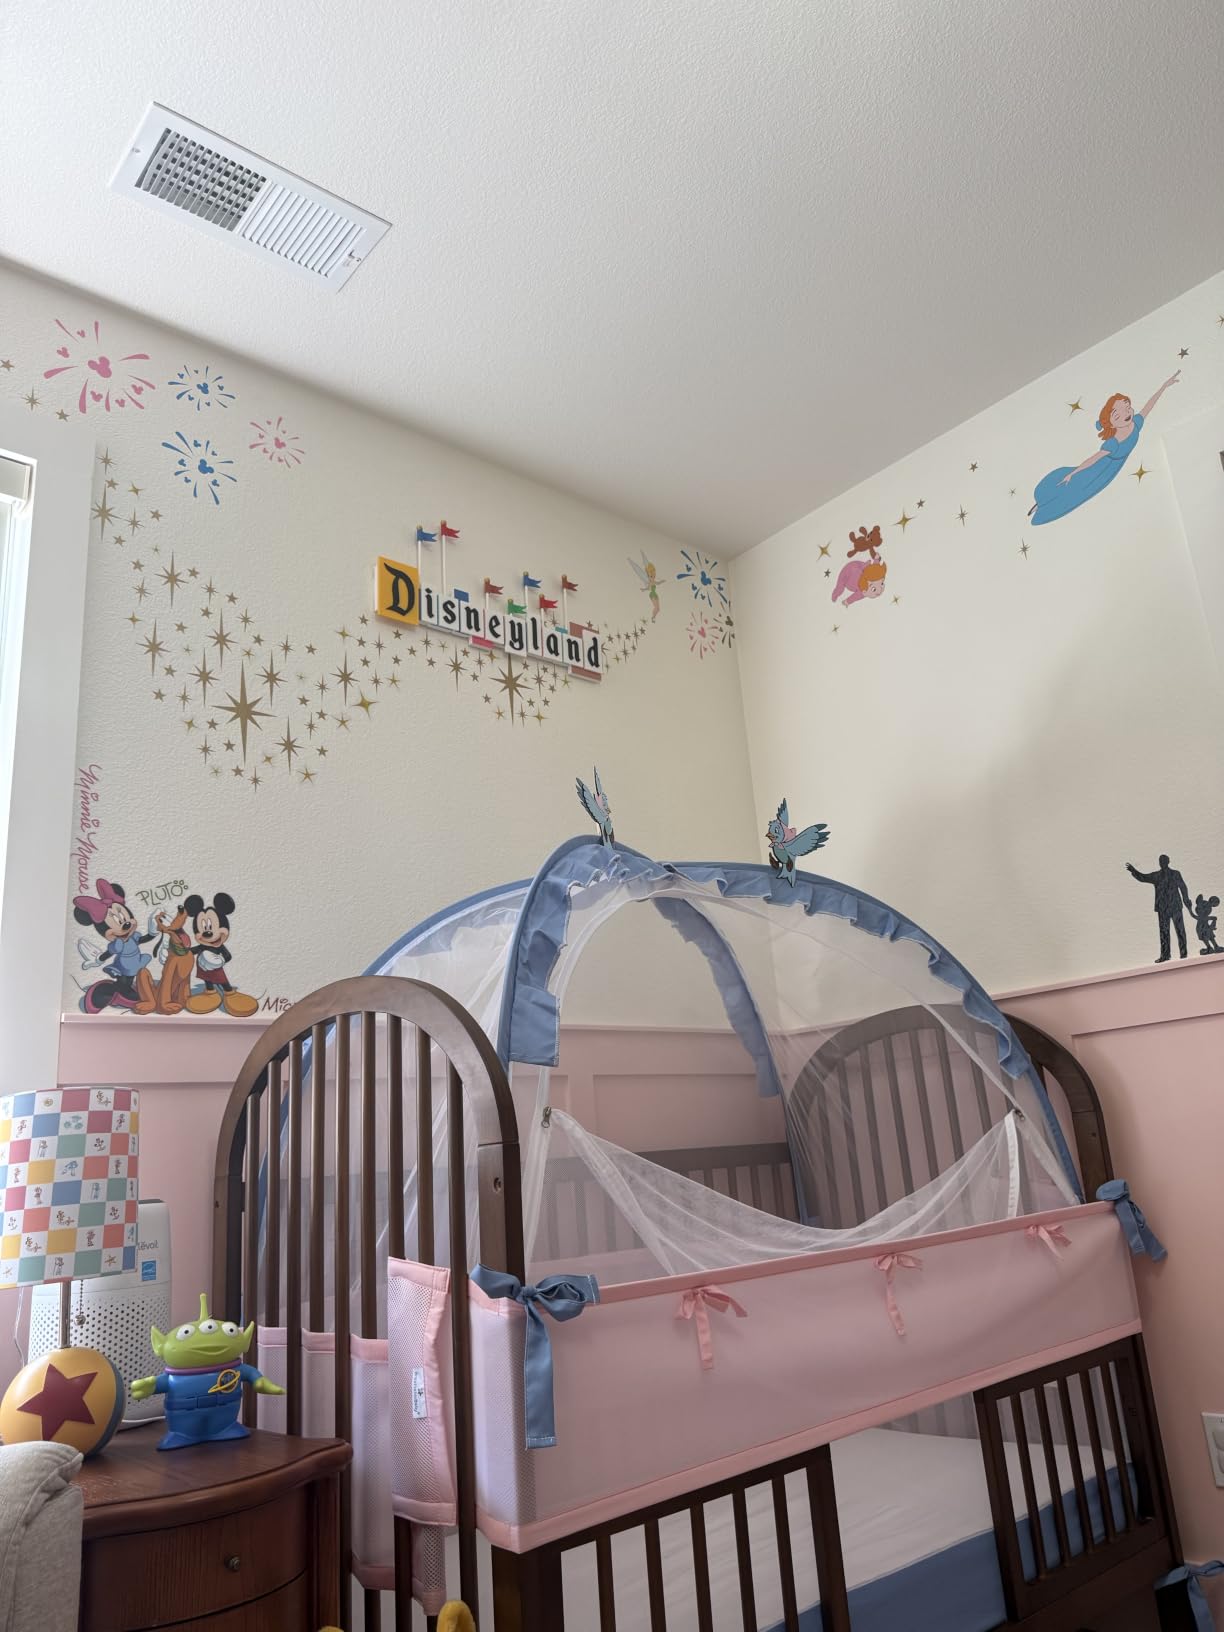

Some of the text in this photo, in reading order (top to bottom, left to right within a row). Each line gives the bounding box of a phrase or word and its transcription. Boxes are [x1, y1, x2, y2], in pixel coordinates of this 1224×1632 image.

[384, 562, 600, 668] Disneyland
[70, 764, 102, 893] Minnie Mouse
[135, 880, 188, 906] PLUTO
[261, 997, 292, 1013] Mic
